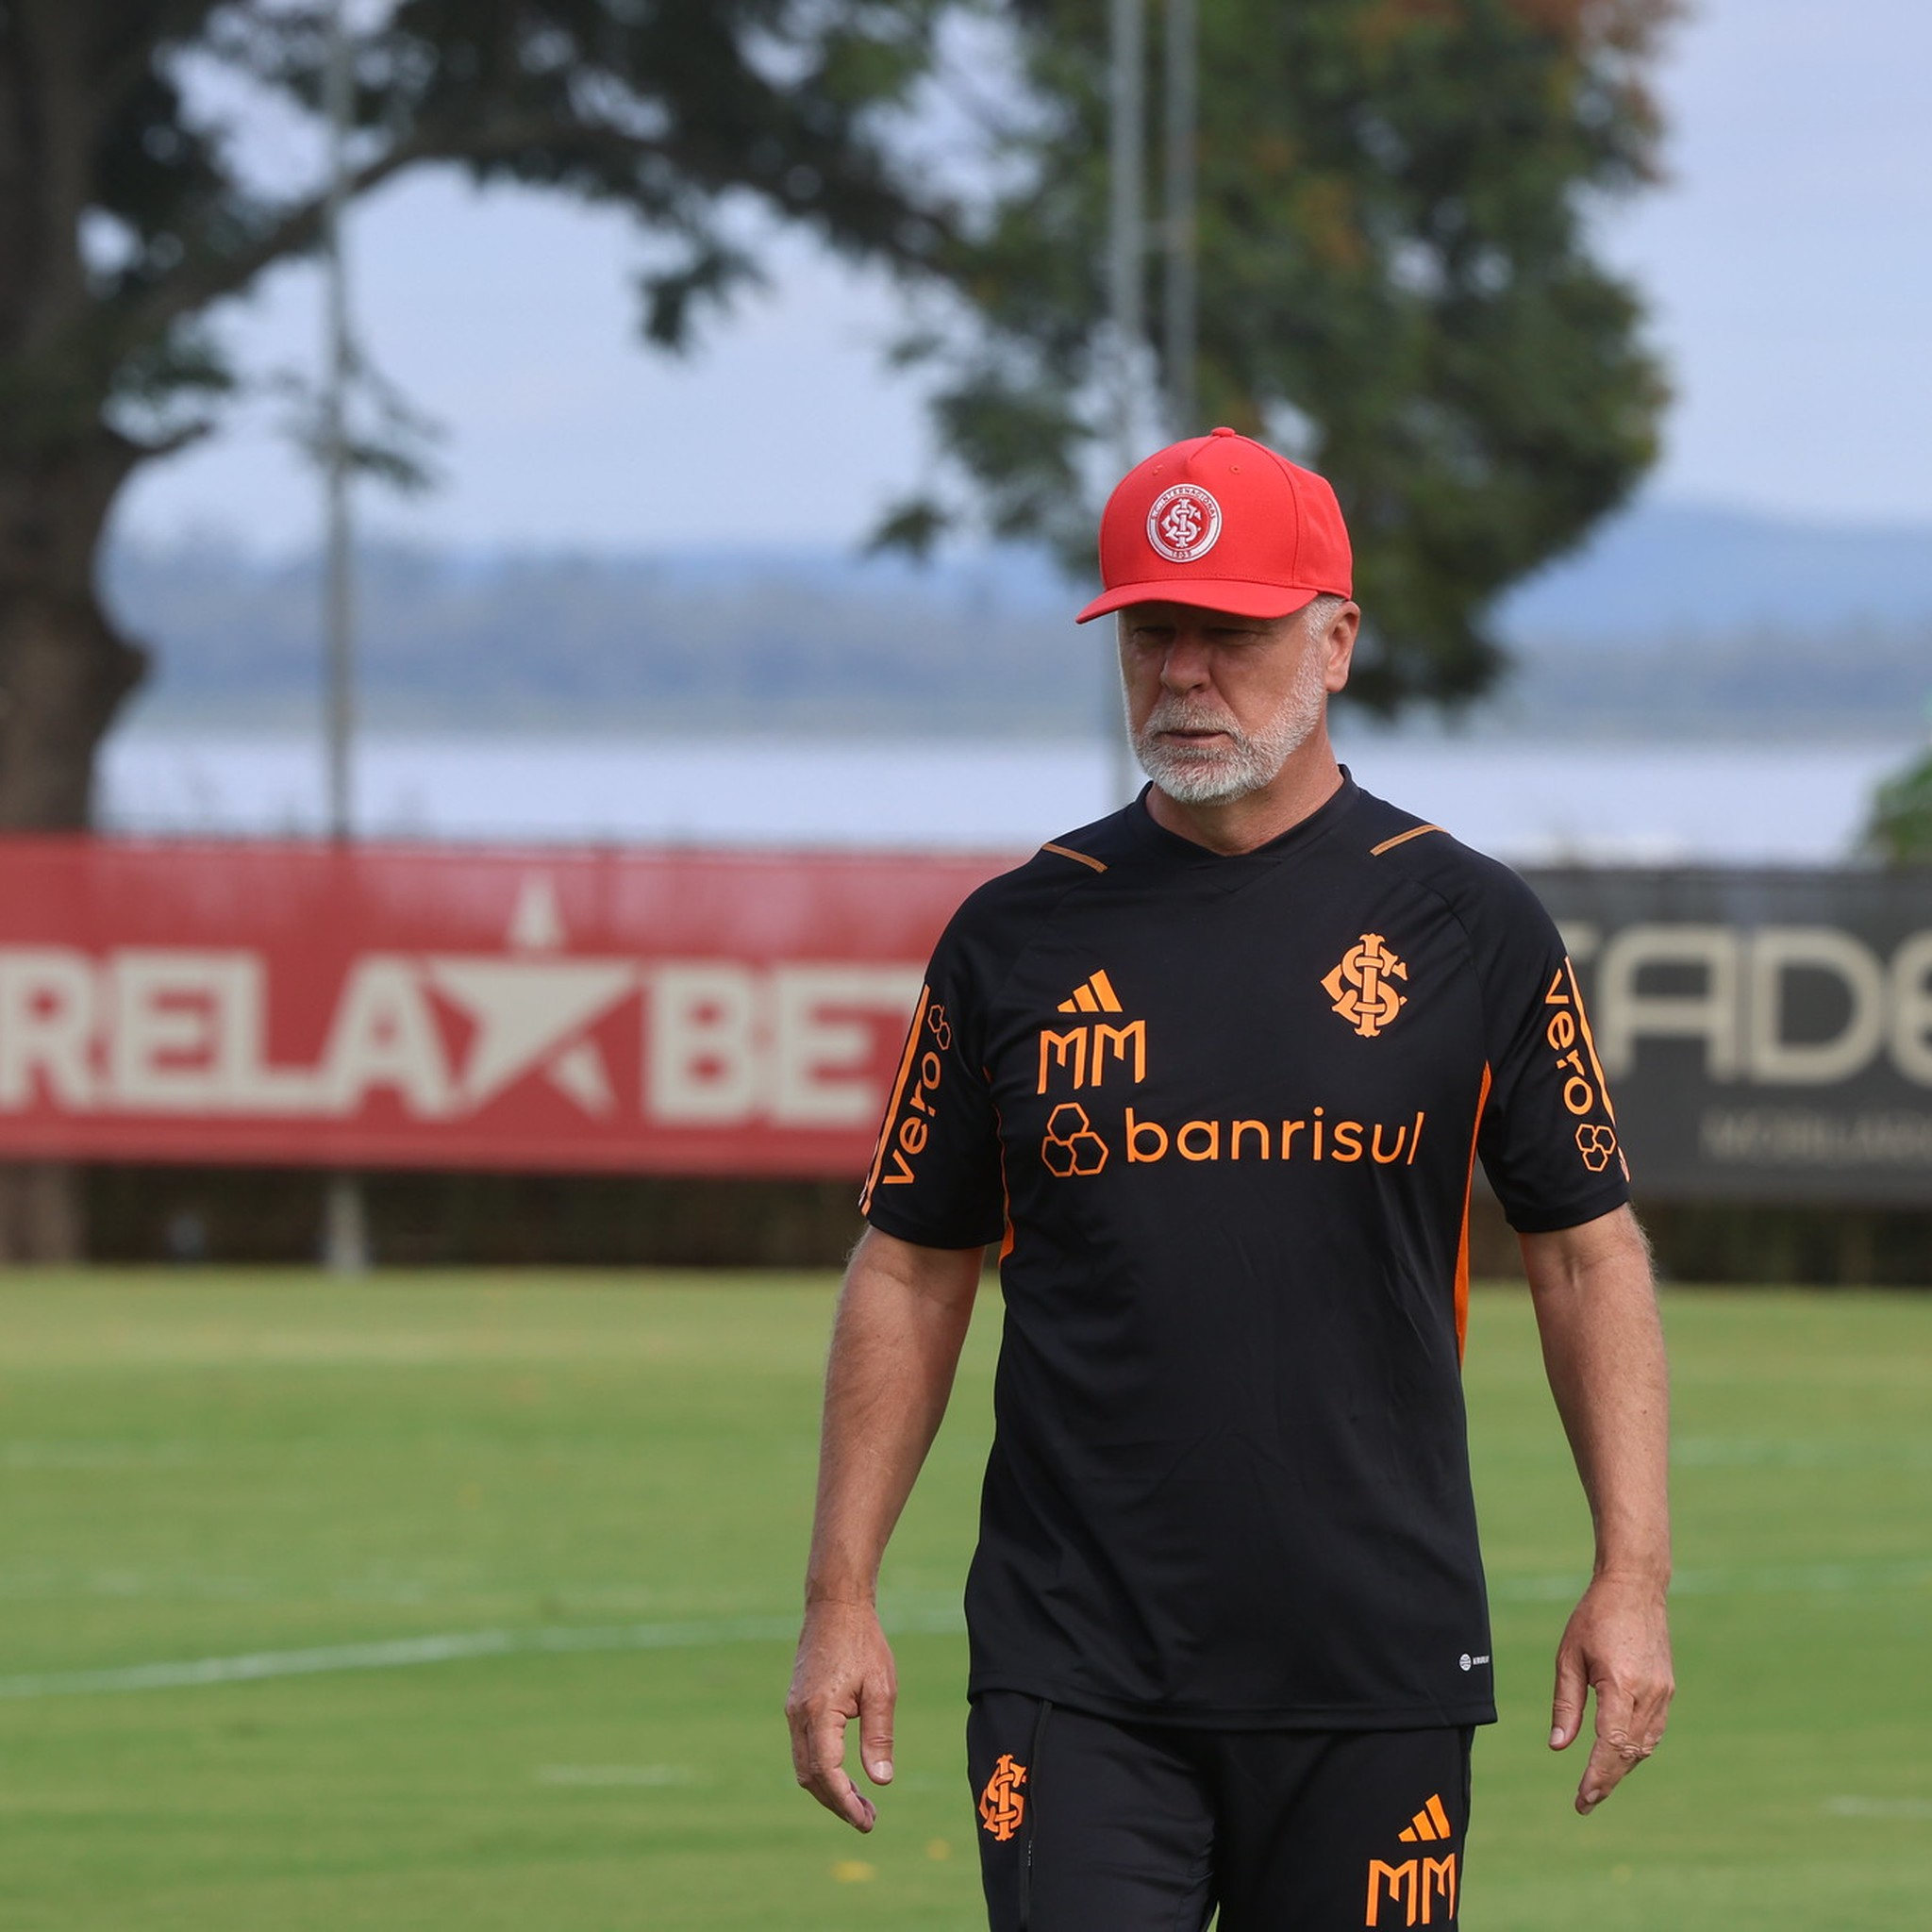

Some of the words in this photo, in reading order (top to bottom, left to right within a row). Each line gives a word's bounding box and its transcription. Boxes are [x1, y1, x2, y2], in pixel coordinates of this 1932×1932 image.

[0, 946, 453, 1120] RELA
[1037, 1020, 1145, 1094] MM
[1545, 969, 1593, 1114] vero
[882, 1051, 941, 1184] vero
[1125, 1107, 1424, 1165] banrisul
[1366, 1853, 1456, 1927] MM
